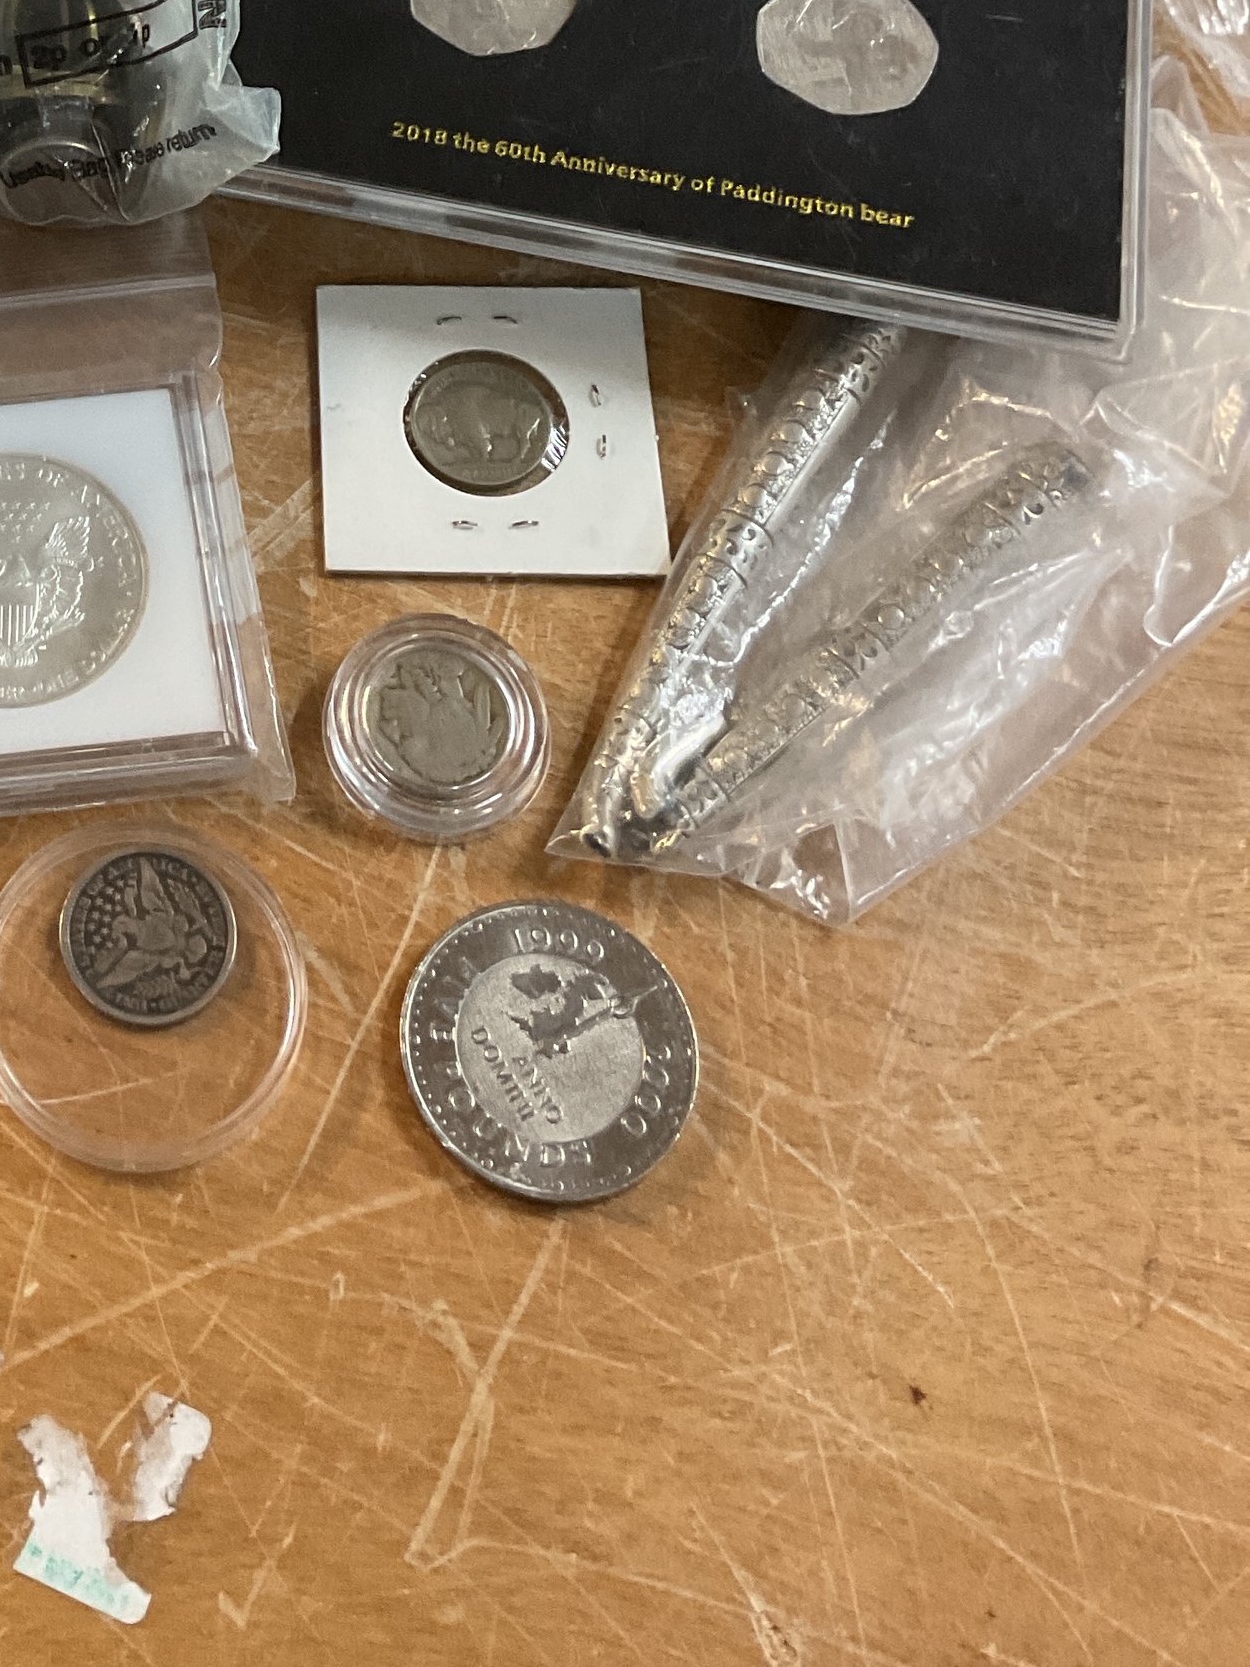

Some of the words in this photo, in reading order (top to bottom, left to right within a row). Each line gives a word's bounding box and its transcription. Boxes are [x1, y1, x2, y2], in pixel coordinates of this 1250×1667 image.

[391, 120, 448, 148] 2018
[452, 130, 491, 155] the
[495, 139, 546, 167] 60th
[550, 148, 686, 194] Anniversary
[691, 171, 716, 194] of
[720, 178, 855, 222] Paddington
[860, 201, 915, 230] bear
